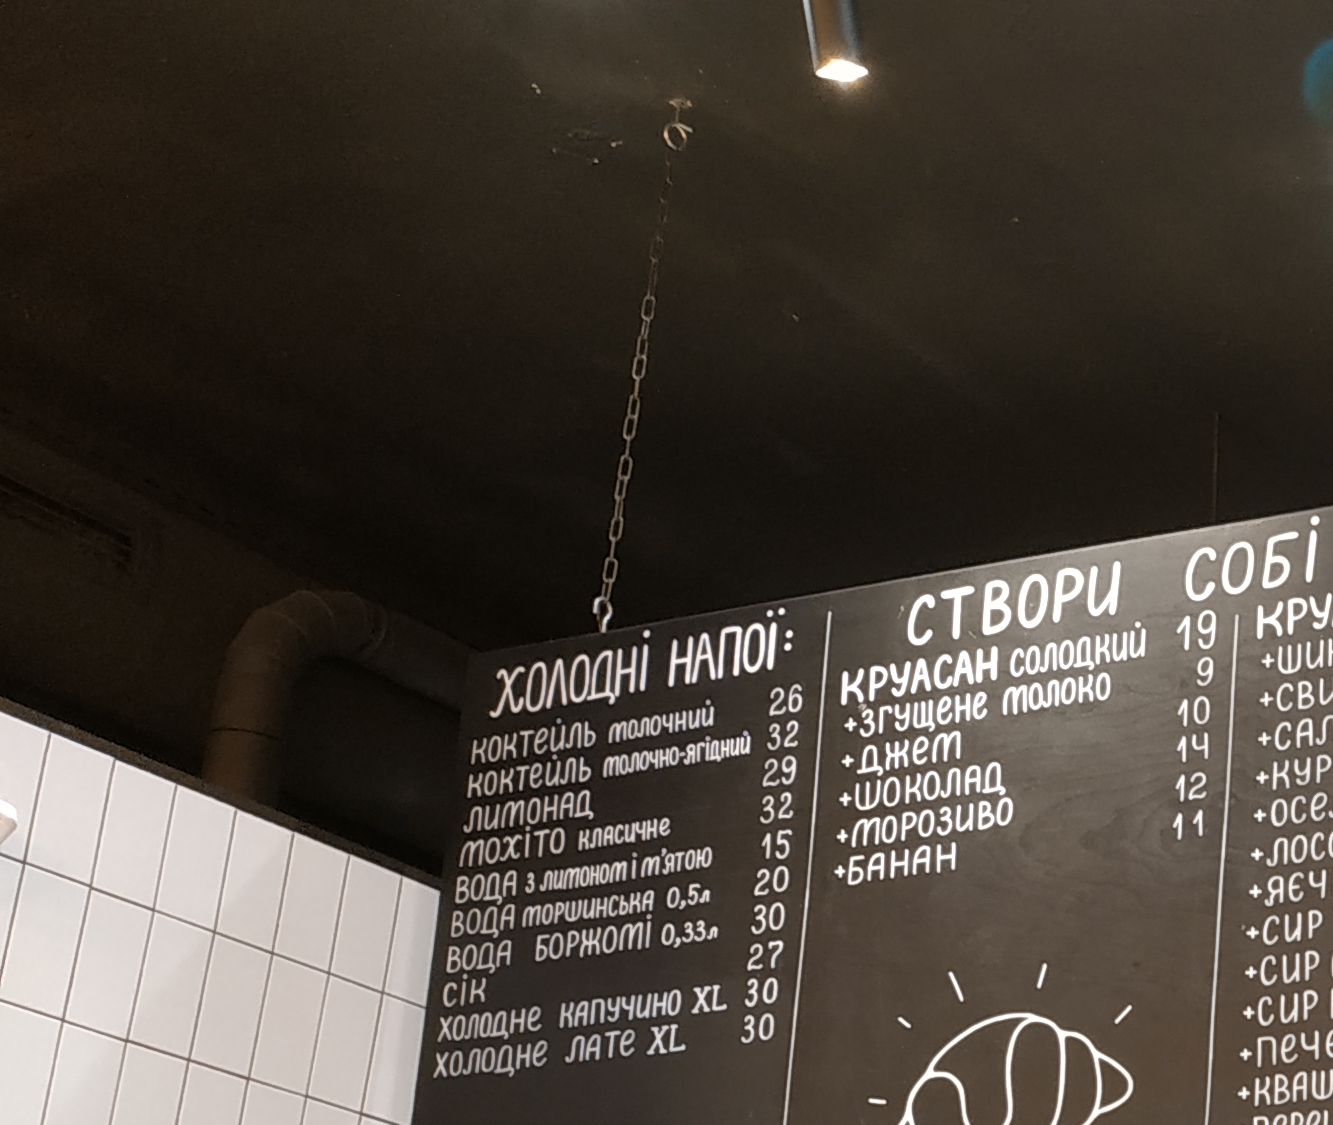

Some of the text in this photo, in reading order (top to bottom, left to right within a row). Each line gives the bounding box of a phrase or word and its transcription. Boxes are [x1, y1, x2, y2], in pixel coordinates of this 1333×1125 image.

[908, 561, 1121, 645] СТВОРИ
[1186, 516, 1320, 601] СОБІ
[490, 630, 650, 718] ХОЛОДНІ
[841, 610, 1216, 705] КРУАСАН СОЛОДКИЙ 19
[1003, 673, 1111, 715] МОЛОКО
[1178, 696, 1210, 727] 10
[471, 700, 714, 764] КОКТЕЙЛЬ МОЛОЧНИЙ
[467, 731, 750, 798] КОКТЕЙЛЬ МОЛОЧНО-ЯГІДНИЙ
[459, 792, 793, 867] МОХІТО КЛАСИЧНЕ 32
[463, 790, 594, 833] ЛИМОНАД
[451, 904, 515, 938] ВОДА
[522, 890, 654, 927] МОРШИНСЬКА
[754, 866, 789, 896] 20
[455, 870, 516, 905] ВОДА
[540, 861, 627, 891] ЛИМОНОМ
[536, 914, 652, 961] БОРЖОМІ
[751, 902, 785, 934] 30
[439, 985, 727, 1040] ХОЛОДНЕ КАПУЧИНО XL
[444, 974, 486, 1006] СІК
[565, 1030, 635, 1063] ЛАТЕ
